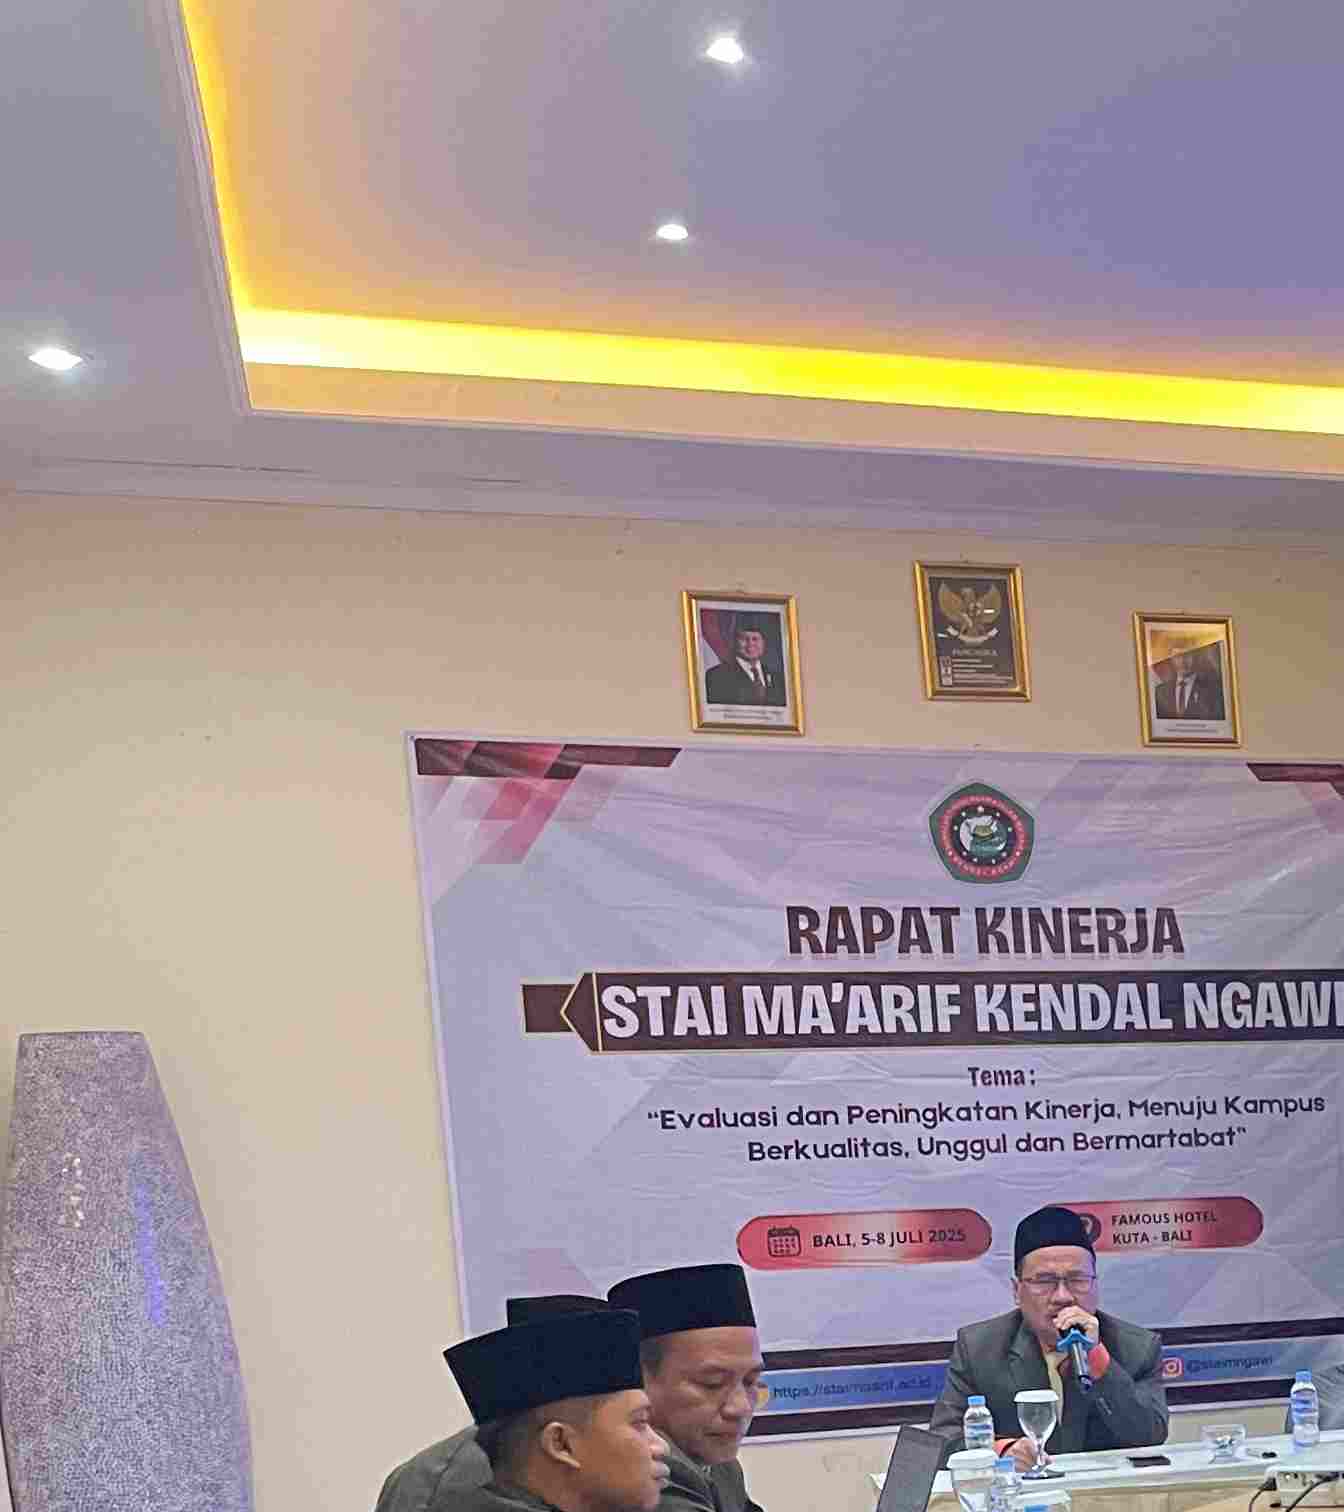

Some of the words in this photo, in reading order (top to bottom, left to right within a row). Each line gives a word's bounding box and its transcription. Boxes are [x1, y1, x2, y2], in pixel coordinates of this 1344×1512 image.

[785, 905, 961, 955] RAPAT
[974, 906, 1185, 955] KINERJA
[600, 984, 728, 1037] STAI
[742, 982, 961, 1036] MA'ARIF
[974, 982, 1174, 1032] KENDAL
[786, 1104, 840, 1127] dan
[847, 1100, 1018, 1130] Peningkatan
[1024, 1097, 1122, 1125] Kinerja,
[1128, 1095, 1217, 1119] Menuju
[1224, 1094, 1326, 1118] Kampus
[748, 1137, 910, 1162] Berkualitas,
[917, 1133, 1008, 1162] Unggul
[1015, 1132, 1066, 1153] dan
[1111, 1212, 1171, 1226] FAMOUS
[1174, 1210, 1217, 1223] HOTEL
[812, 1232, 857, 1249] BALI,
[861, 1232, 886, 1246] 5-8
[888, 1230, 924, 1247] JULI
[928, 1228, 967, 1243] 2025
[1112, 1231, 1150, 1245] KUTA
[1161, 1230, 1193, 1242] BALI
